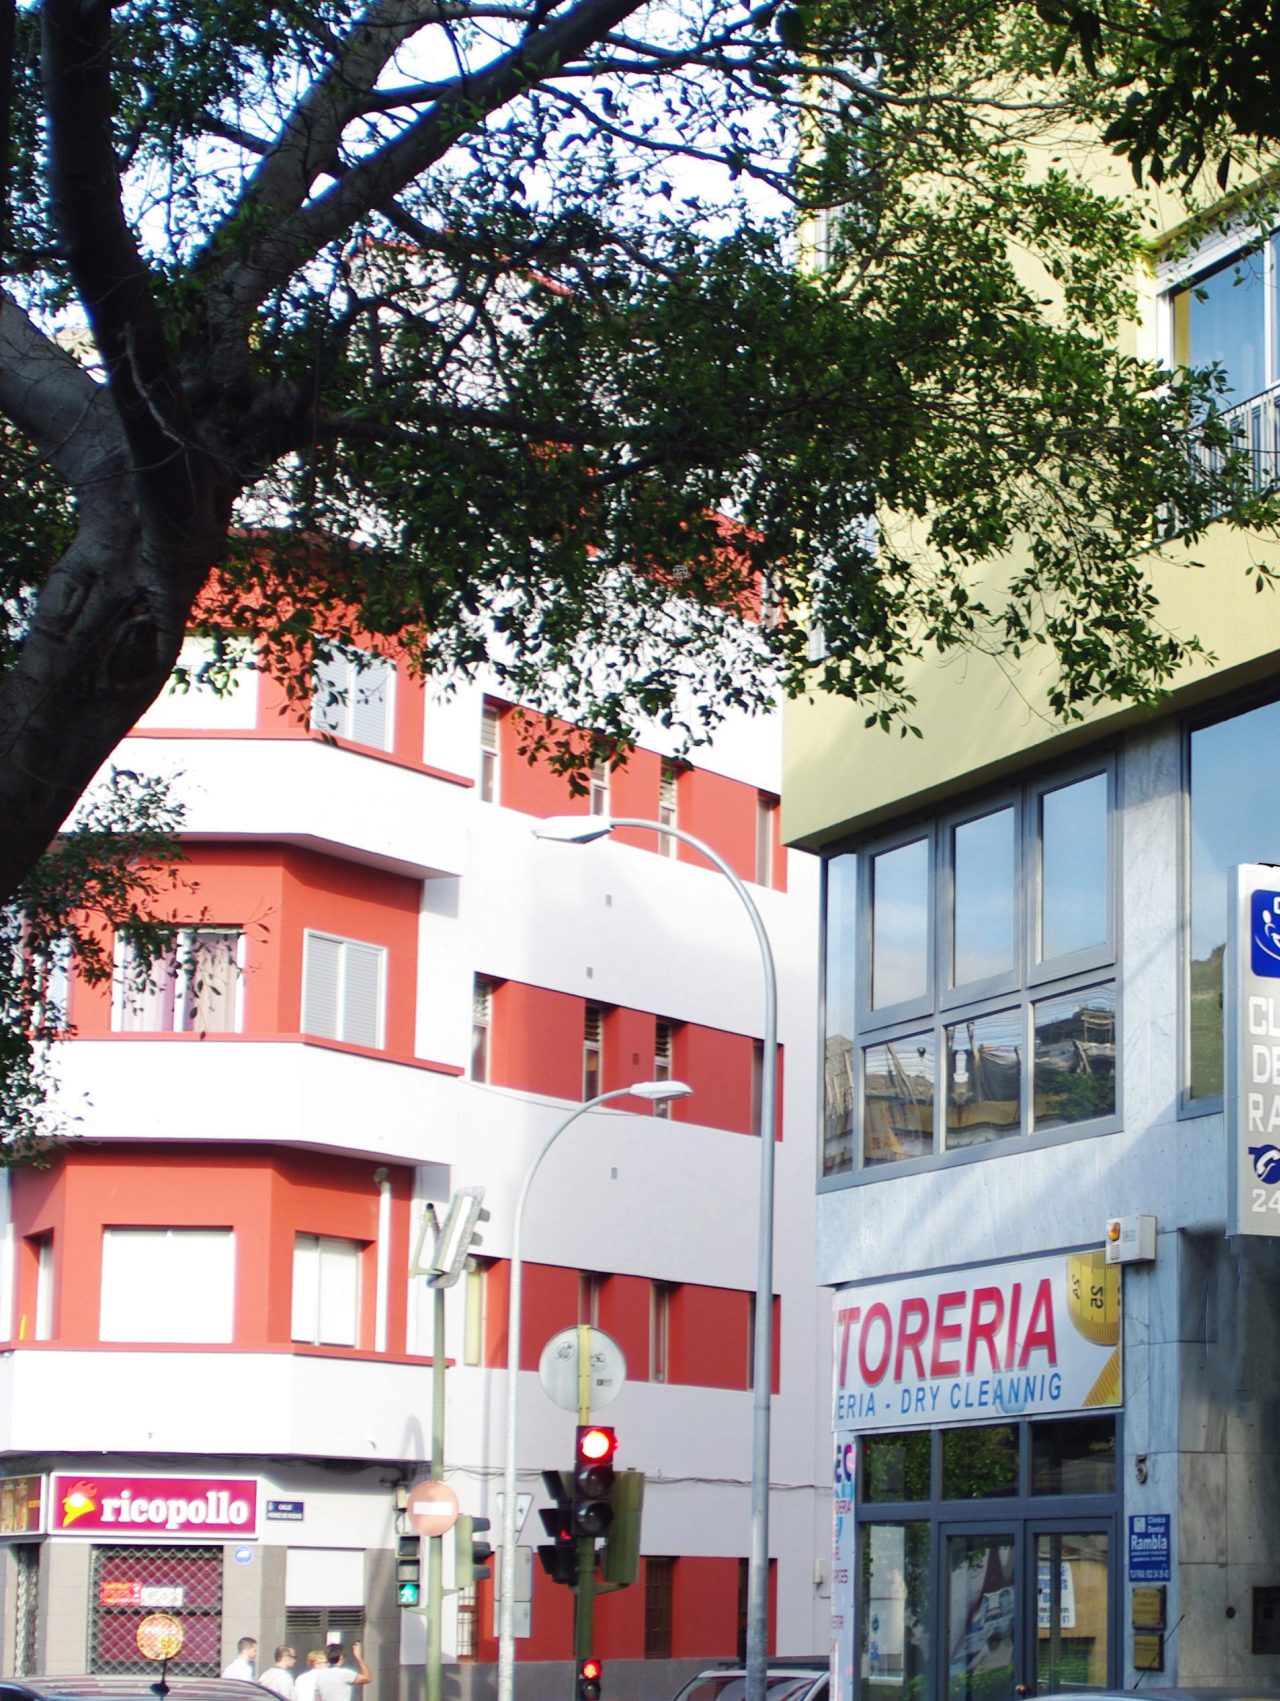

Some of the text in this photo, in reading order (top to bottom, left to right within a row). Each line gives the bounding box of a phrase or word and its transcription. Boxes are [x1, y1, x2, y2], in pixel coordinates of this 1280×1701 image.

[900, 1384, 941, 1416] DRY
[949, 1372, 1063, 1411] CLEANNIG
[100, 1489, 249, 1530] ricopollo
[1131, 1534, 1168, 1550] Rambla
